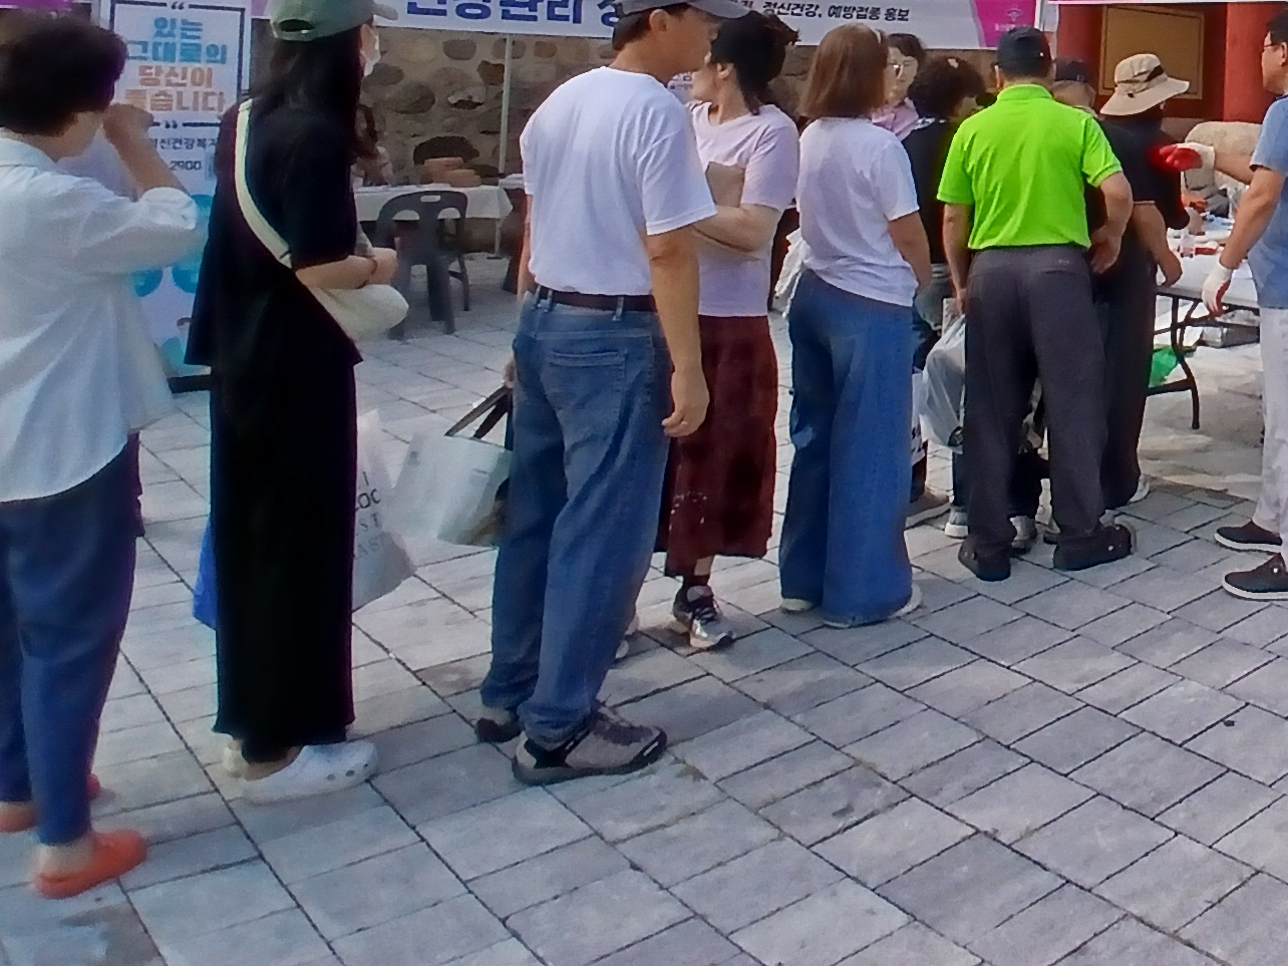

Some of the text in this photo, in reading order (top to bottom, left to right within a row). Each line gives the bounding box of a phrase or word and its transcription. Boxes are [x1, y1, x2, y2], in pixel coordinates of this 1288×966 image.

[884, 7, 911, 22] 홍보
[153, 16, 204, 41] 있는
[126, 39, 228, 65] 그대로의
[138, 64, 214, 89] 당신이
